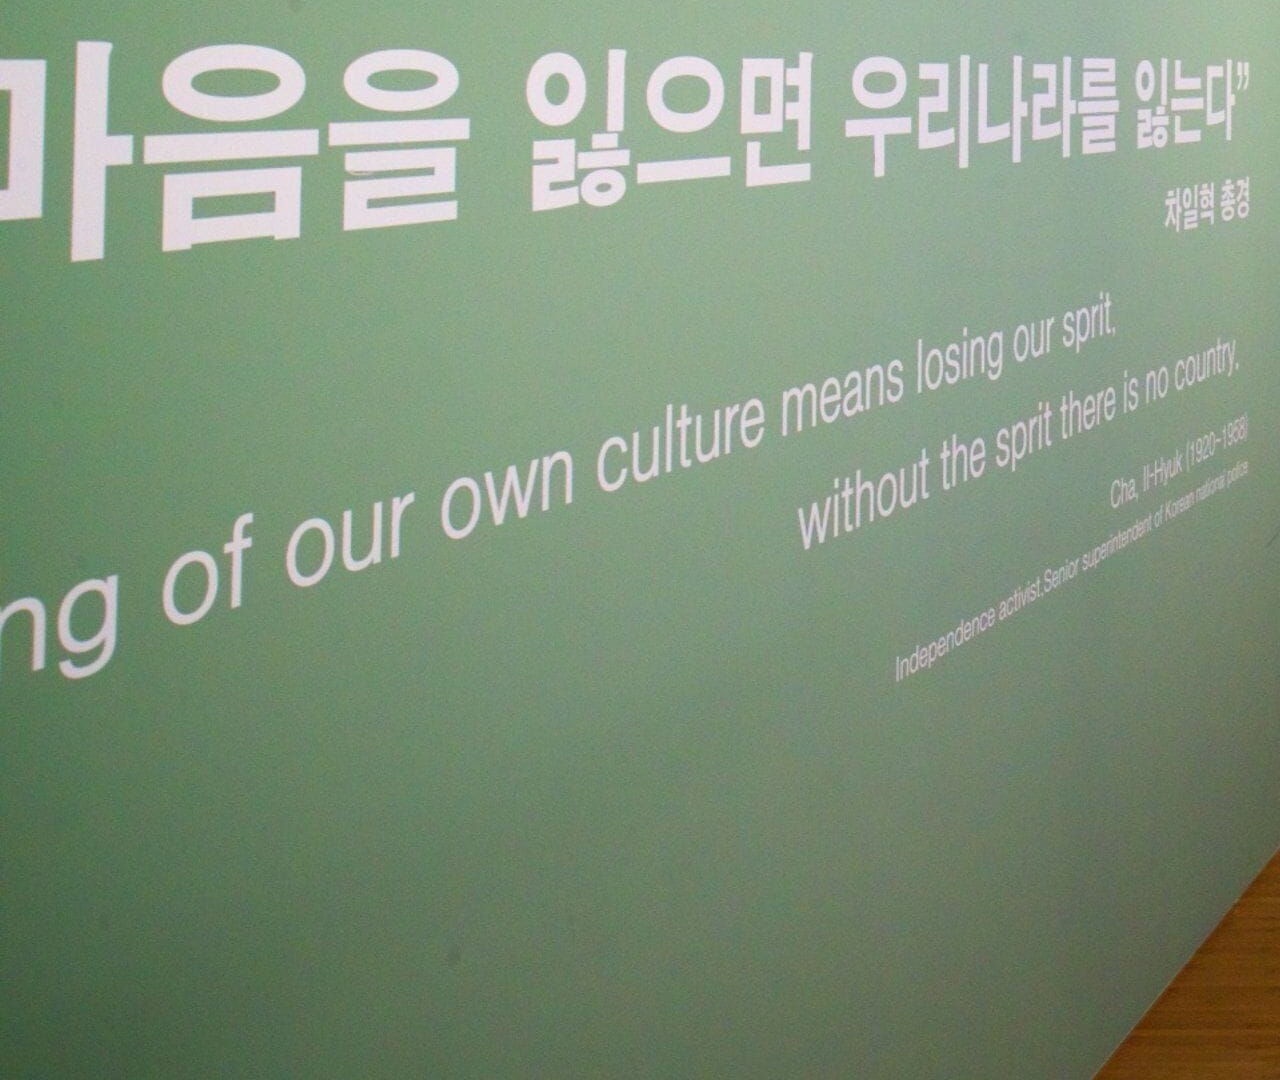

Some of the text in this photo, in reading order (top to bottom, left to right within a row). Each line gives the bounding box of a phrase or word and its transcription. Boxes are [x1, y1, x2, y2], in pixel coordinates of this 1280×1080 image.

[0, 41, 470, 262] 마음을
[526, 49, 813, 212] 잃으면
[845, 55, 1119, 178] 우리나라를
[1165, 177, 1249, 232] 차일혁 총경
[163, 513, 253, 625] of
[286, 493, 414, 587] our
[442, 451, 572, 539] own
[597, 399, 764, 492] culture
[782, 359, 903, 436] means
[917, 327, 1003, 393] losing
[1013, 317, 1055, 362] our
[1063, 292, 1115, 353] sprit,
[798, 449, 929, 550] without
[940, 434, 986, 490] the
[996, 402, 1052, 472] sprit
[1060, 387, 1116, 439] there
[1124, 370, 1139, 413] is
[1146, 366, 1169, 403] no
[1110, 478, 1138, 508] Cha,
[895, 608, 995, 682] Independence
[1082, 514, 1152, 571] superintendent
[1154, 505, 1163, 527] of
[1165, 492, 1194, 520] Korean
[1196, 472, 1228, 501] national
[1227, 461, 1249, 486] police
